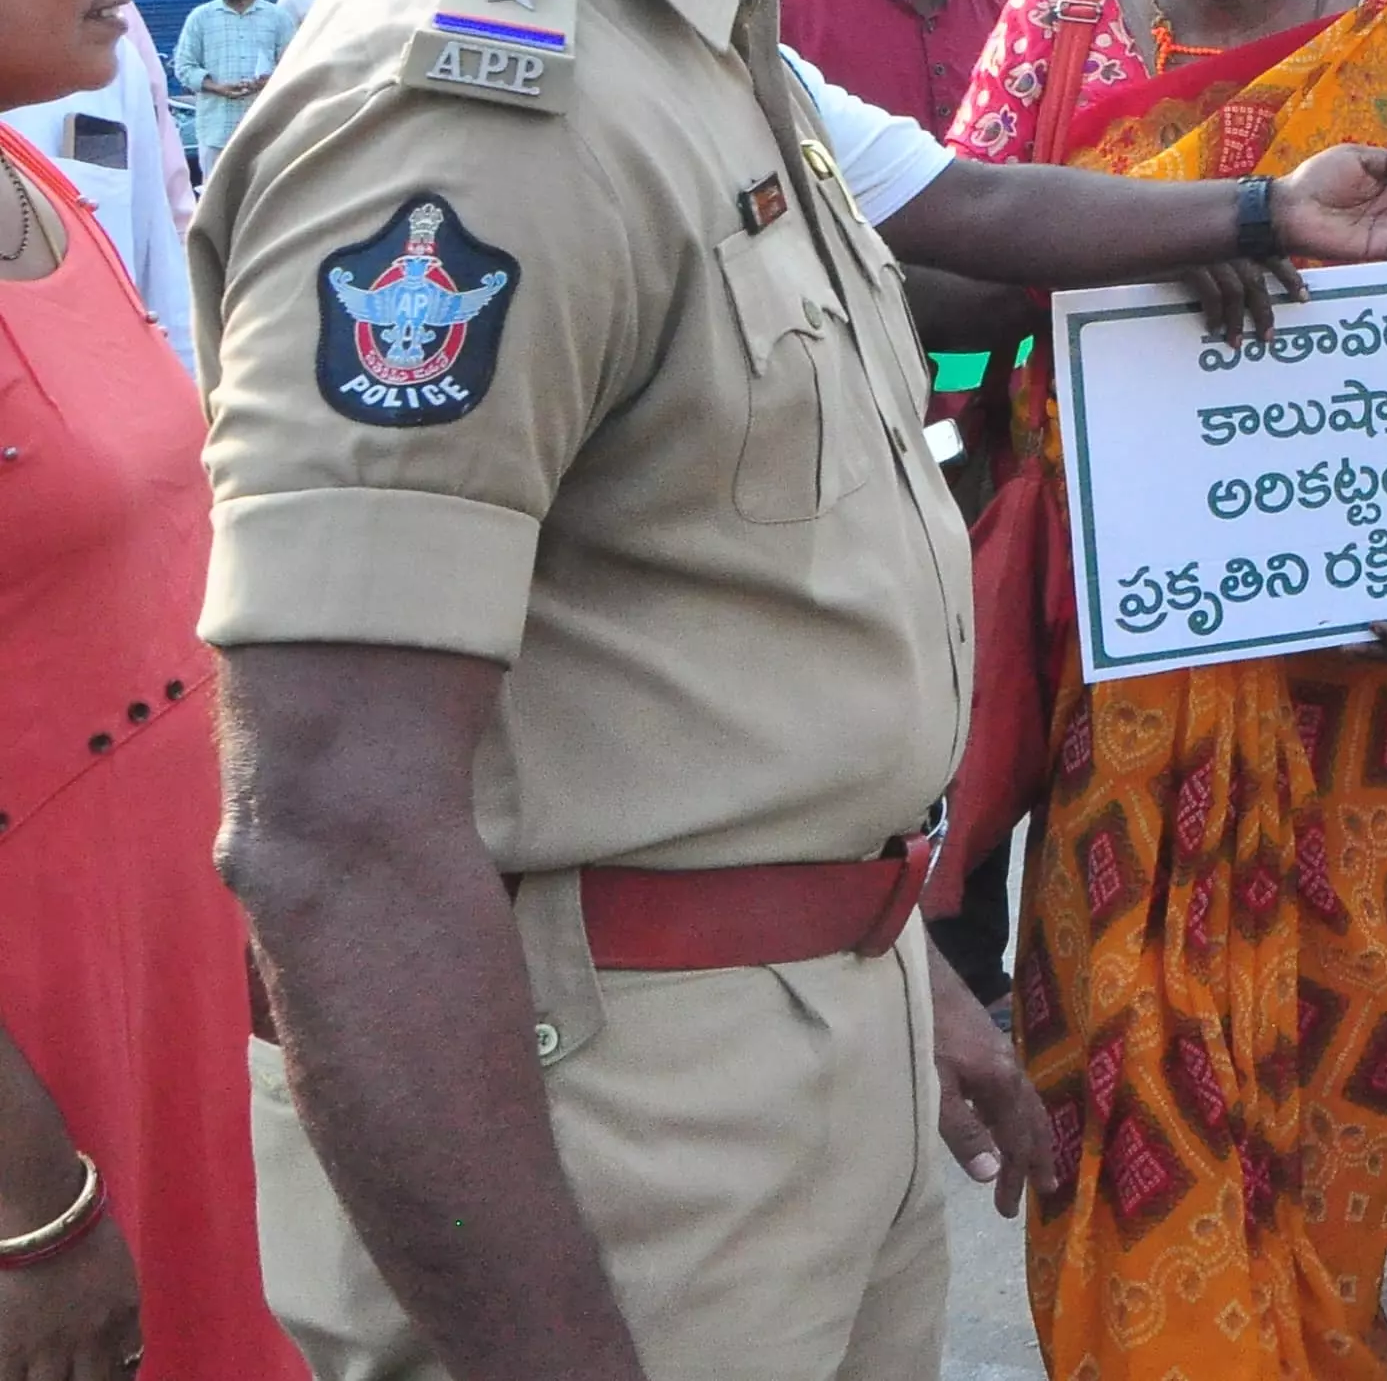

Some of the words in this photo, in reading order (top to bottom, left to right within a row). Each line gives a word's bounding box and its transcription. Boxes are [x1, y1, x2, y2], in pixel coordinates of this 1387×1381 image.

[398, 291, 428, 318] AP
[340, 372, 470, 410] POLICE
[1115, 552, 1310, 636] ప్రకృతిని
